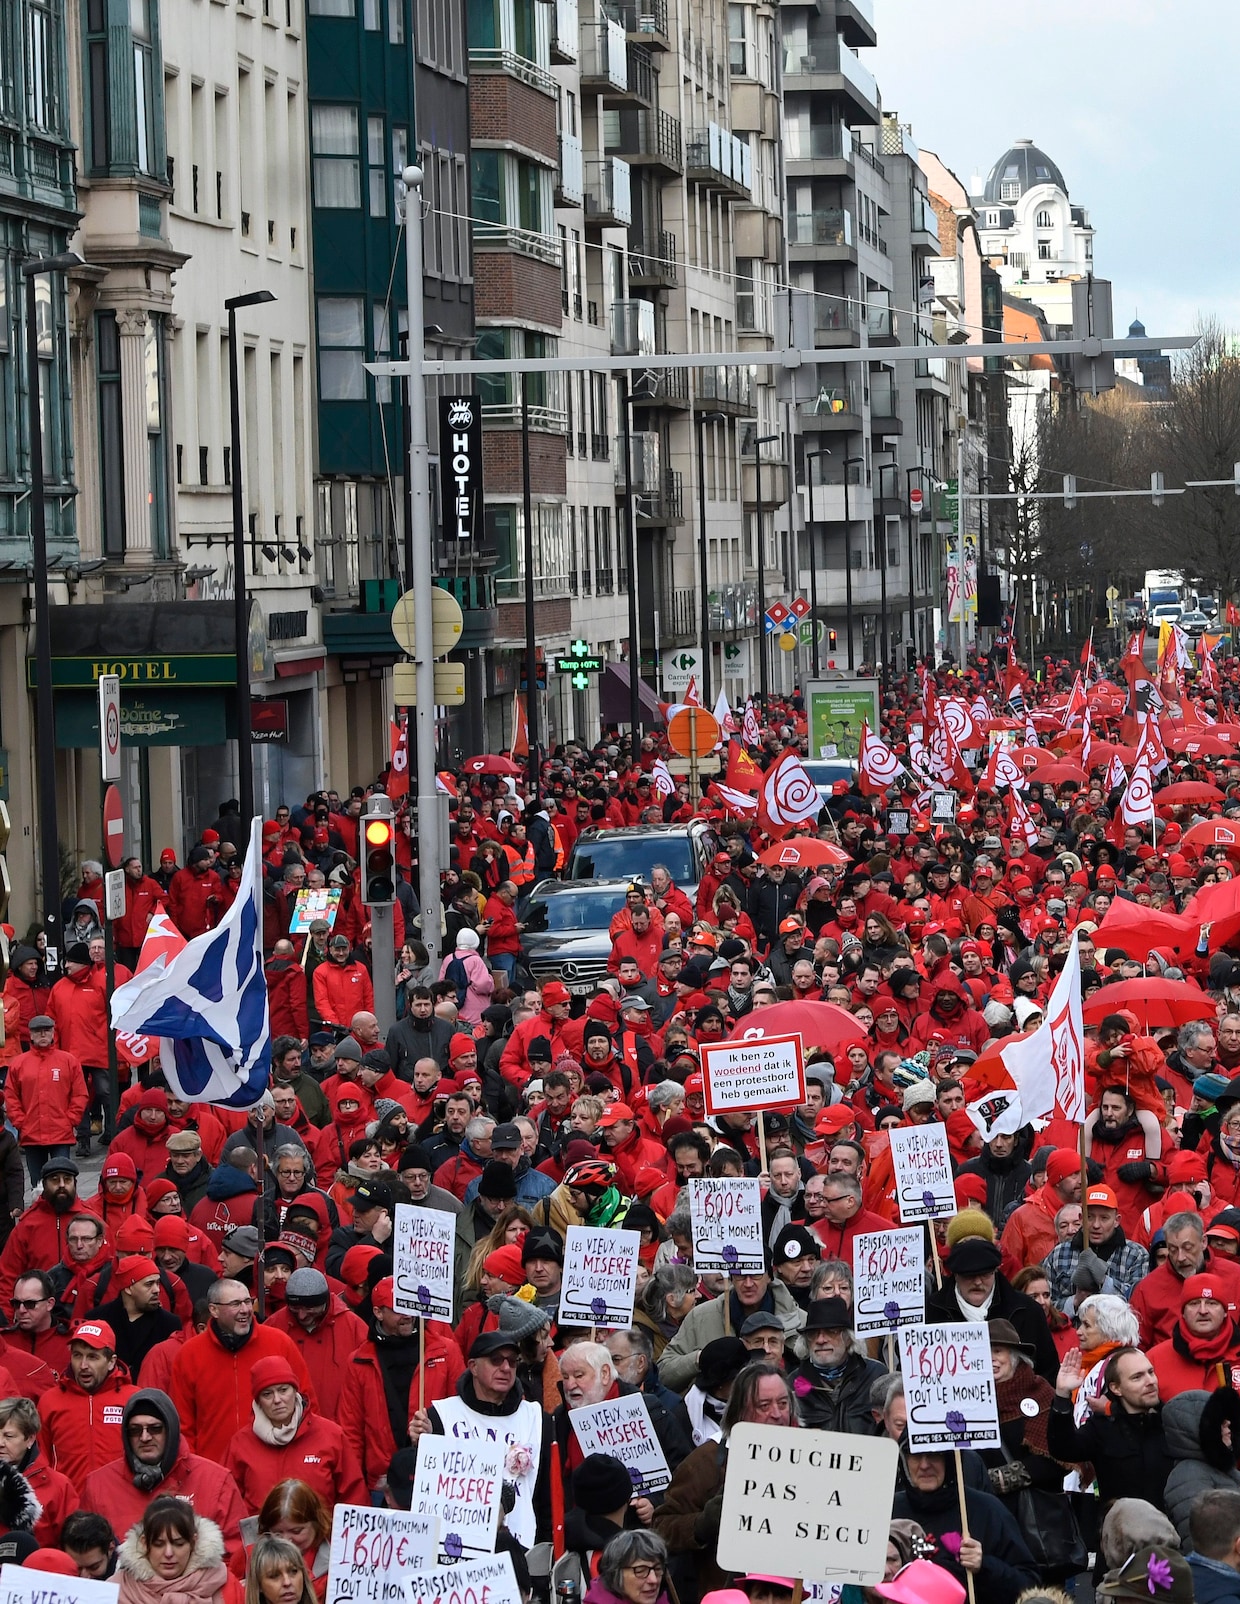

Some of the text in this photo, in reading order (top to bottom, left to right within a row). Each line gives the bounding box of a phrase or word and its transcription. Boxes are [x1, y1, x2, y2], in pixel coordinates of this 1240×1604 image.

[452, 433, 470, 538] HOTEL
[92, 662, 177, 680] HOTEL
[107, 718, 117, 739] 30
[118, 1029, 147, 1057] ptb
[714, 1059, 792, 1077] woedend dat ik
[729, 1050, 775, 1063] Ik ben zo
[713, 1070, 795, 1089] een protestbord
[721, 1084, 789, 1100] heb gemaakt.
[906, 1134, 930, 1152] VIEUX
[907, 1149, 945, 1169] MISERE
[694, 1179, 727, 1194] PENSION
[694, 1190, 755, 1218] 1600€ NET
[399, 1221, 409, 1233] LES
[409, 1219, 436, 1239] VIEUX
[695, 1221, 760, 1242] TOUT LE MONDE!
[859, 1231, 920, 1251] PENSION MINIMUM
[398, 1237, 449, 1264] LA MISERE
[571, 1238, 634, 1256] LES VIEUX DANS
[397, 1257, 450, 1285] PLUS QUESTION!
[569, 1254, 631, 1276] LA MISERE
[859, 1246, 918, 1278] 1600€ NET
[568, 1274, 631, 1296] PLUS QUESTION!
[858, 1273, 923, 1300] TOUT LE MONDE!
[905, 1328, 983, 1347] PENSION MINIMUM
[906, 1344, 984, 1379] 1600€ NET
[920, 1373, 942, 1387] POUR
[909, 1380, 992, 1405] TOUT LE MONDE!
[579, 1407, 642, 1432] LES VIEUX DANS
[586, 1420, 648, 1450] LA MISERE
[914, 1434, 930, 1443] GANG
[931, 1433, 943, 1441] DES
[945, 1432, 962, 1441] VIEUX
[963, 1431, 973, 1440] EN
[611, 1437, 657, 1461] QUESTION!
[748, 1443, 863, 1472] TOUCHE
[424, 1451, 497, 1477] LES VIEUX DANS
[420, 1473, 494, 1505] LA MISERE
[742, 1479, 843, 1506] PAS A
[342, 1509, 429, 1535] PENSION MINIMUM
[442, 1506, 491, 1531] QUESTION!
[738, 1514, 871, 1545] MA SECU
[339, 1527, 424, 1571] 1600€ NET
[351, 1564, 377, 1577] POUR
[411, 1563, 506, 1599] PENSION MINIMUM
[335, 1577, 378, 1600] TOUT LE
